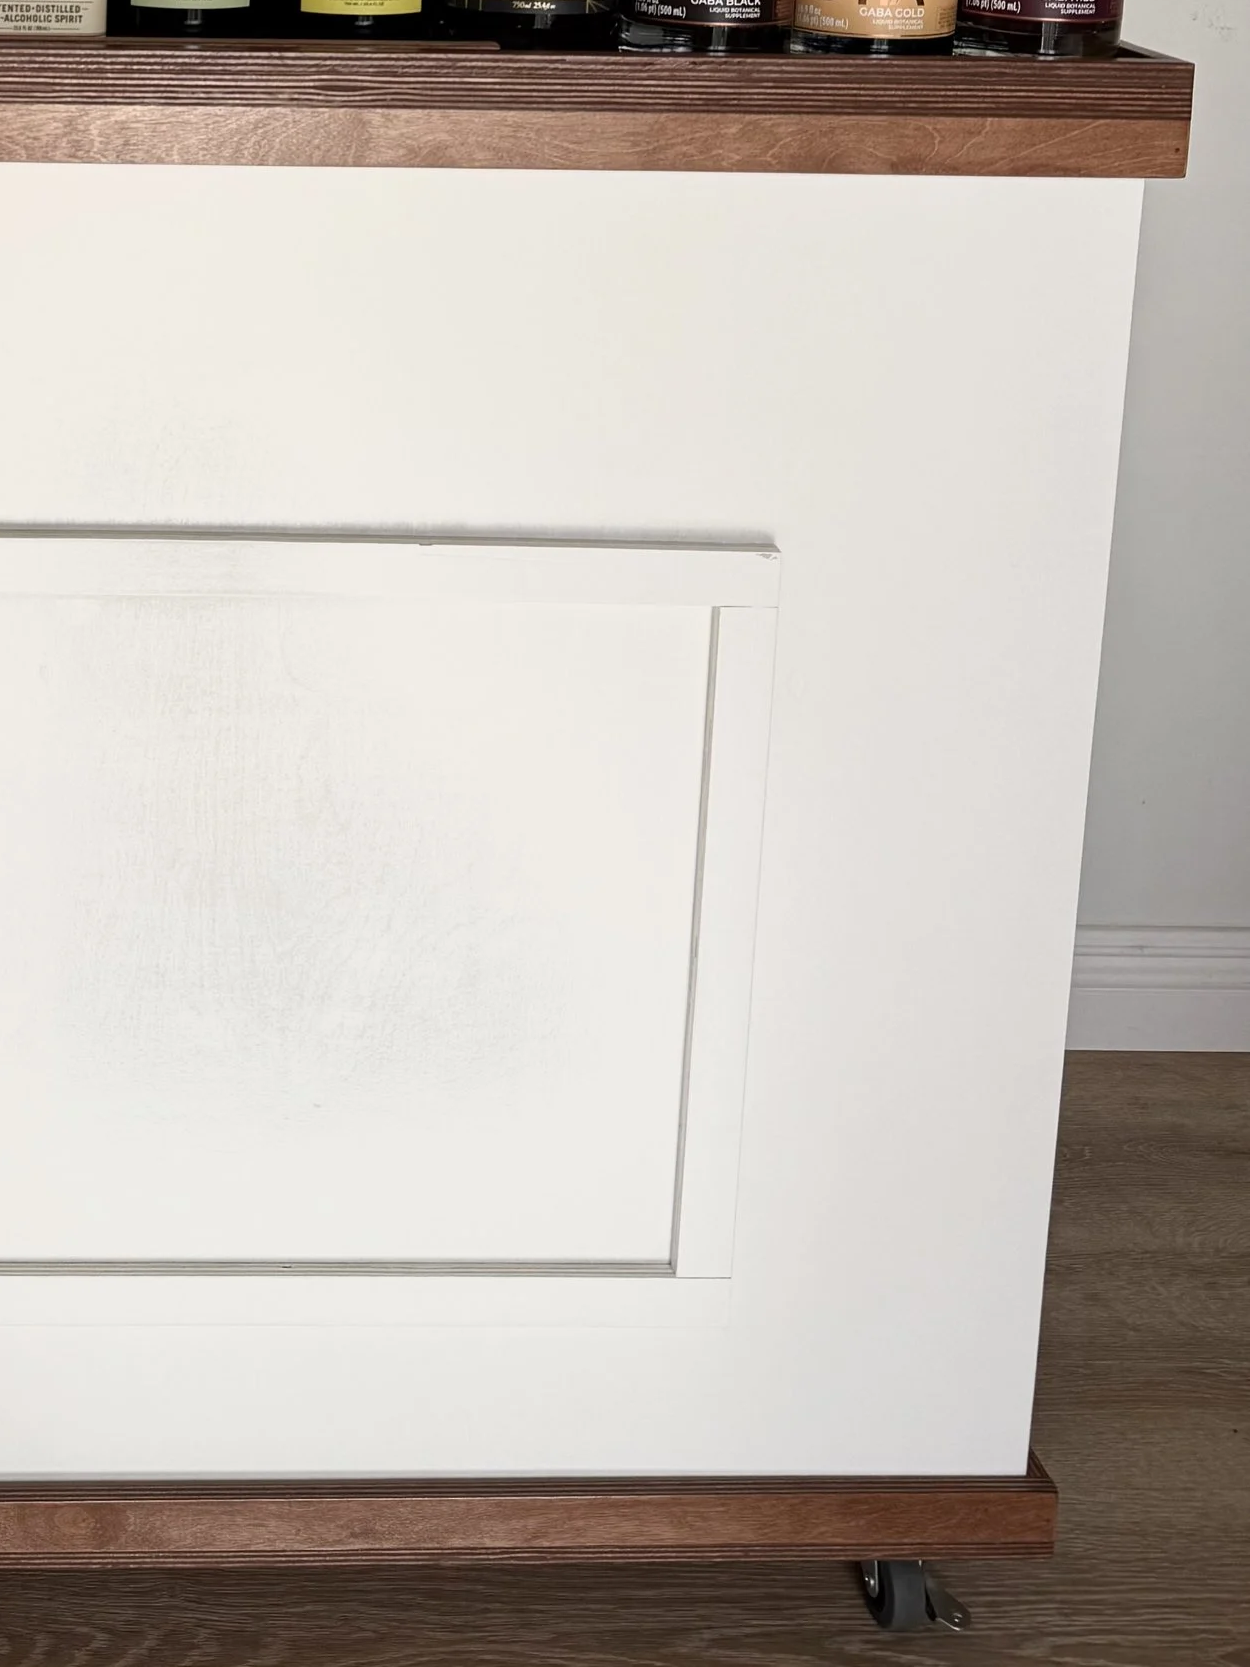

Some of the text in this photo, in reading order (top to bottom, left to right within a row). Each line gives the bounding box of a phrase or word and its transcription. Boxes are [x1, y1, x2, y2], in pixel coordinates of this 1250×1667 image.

[658, 5, 672, 16] (500
[672, 6, 686, 18] mL)
[859, 7, 925, 18] GABA GOLD
[990, 0, 1006, 11] (500
[1007, 1, 1021, 14] mL)
[54, 15, 83, 23] SPIRIT
[819, 16, 834, 26] (500
[835, 19, 849, 30] mL)
